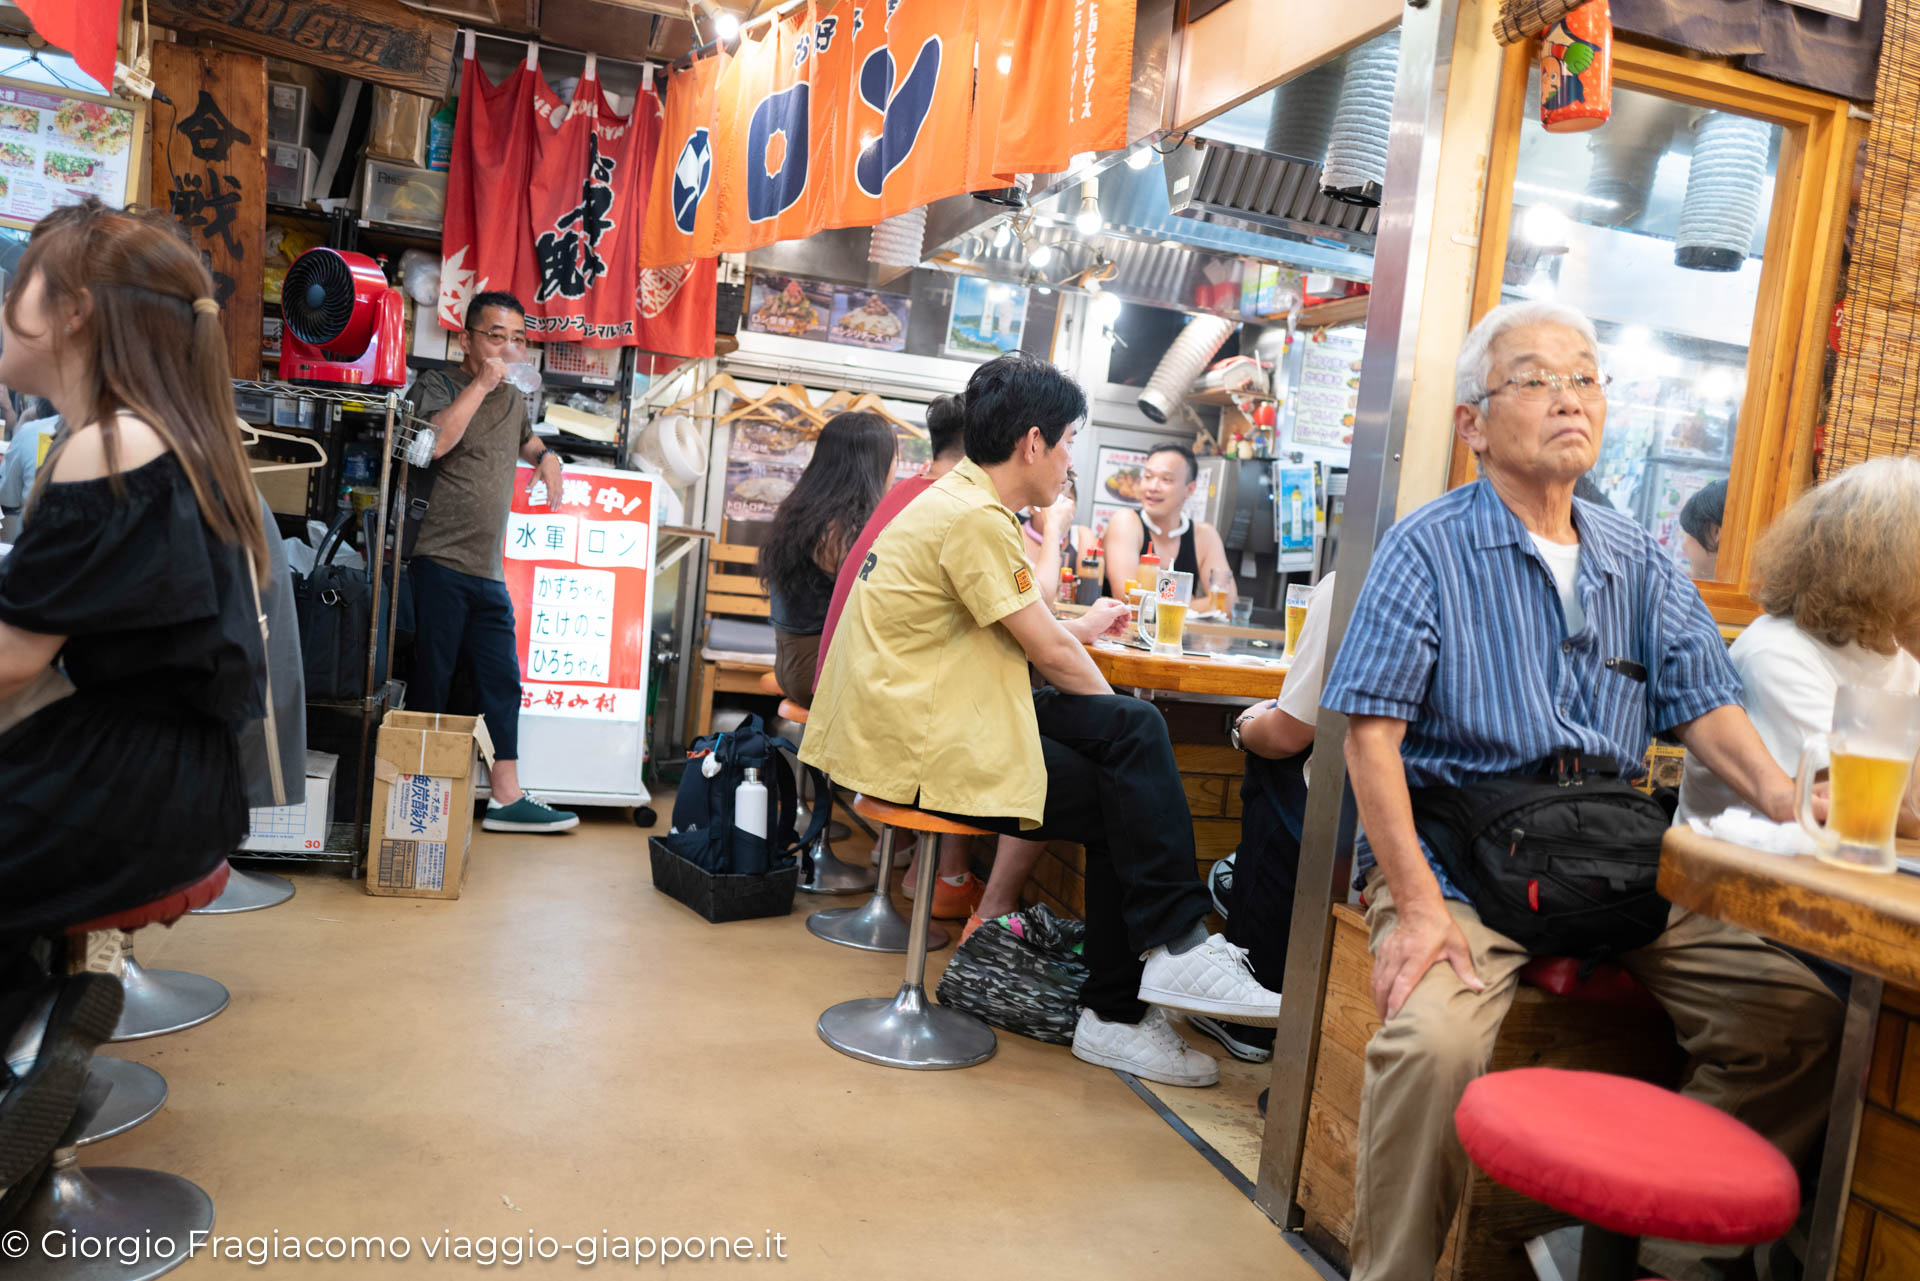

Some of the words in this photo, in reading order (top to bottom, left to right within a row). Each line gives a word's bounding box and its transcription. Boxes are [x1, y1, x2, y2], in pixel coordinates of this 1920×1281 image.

[584, 319, 635, 340] シマルソース
[515, 522, 566, 551] 水軍
[588, 529, 637, 557] ロン
[538, 575, 607, 603] かずちゃん
[536, 610, 606, 638] たけのこ
[533, 648, 603, 678] ひろちゃん
[304, 839, 321, 849] 30
